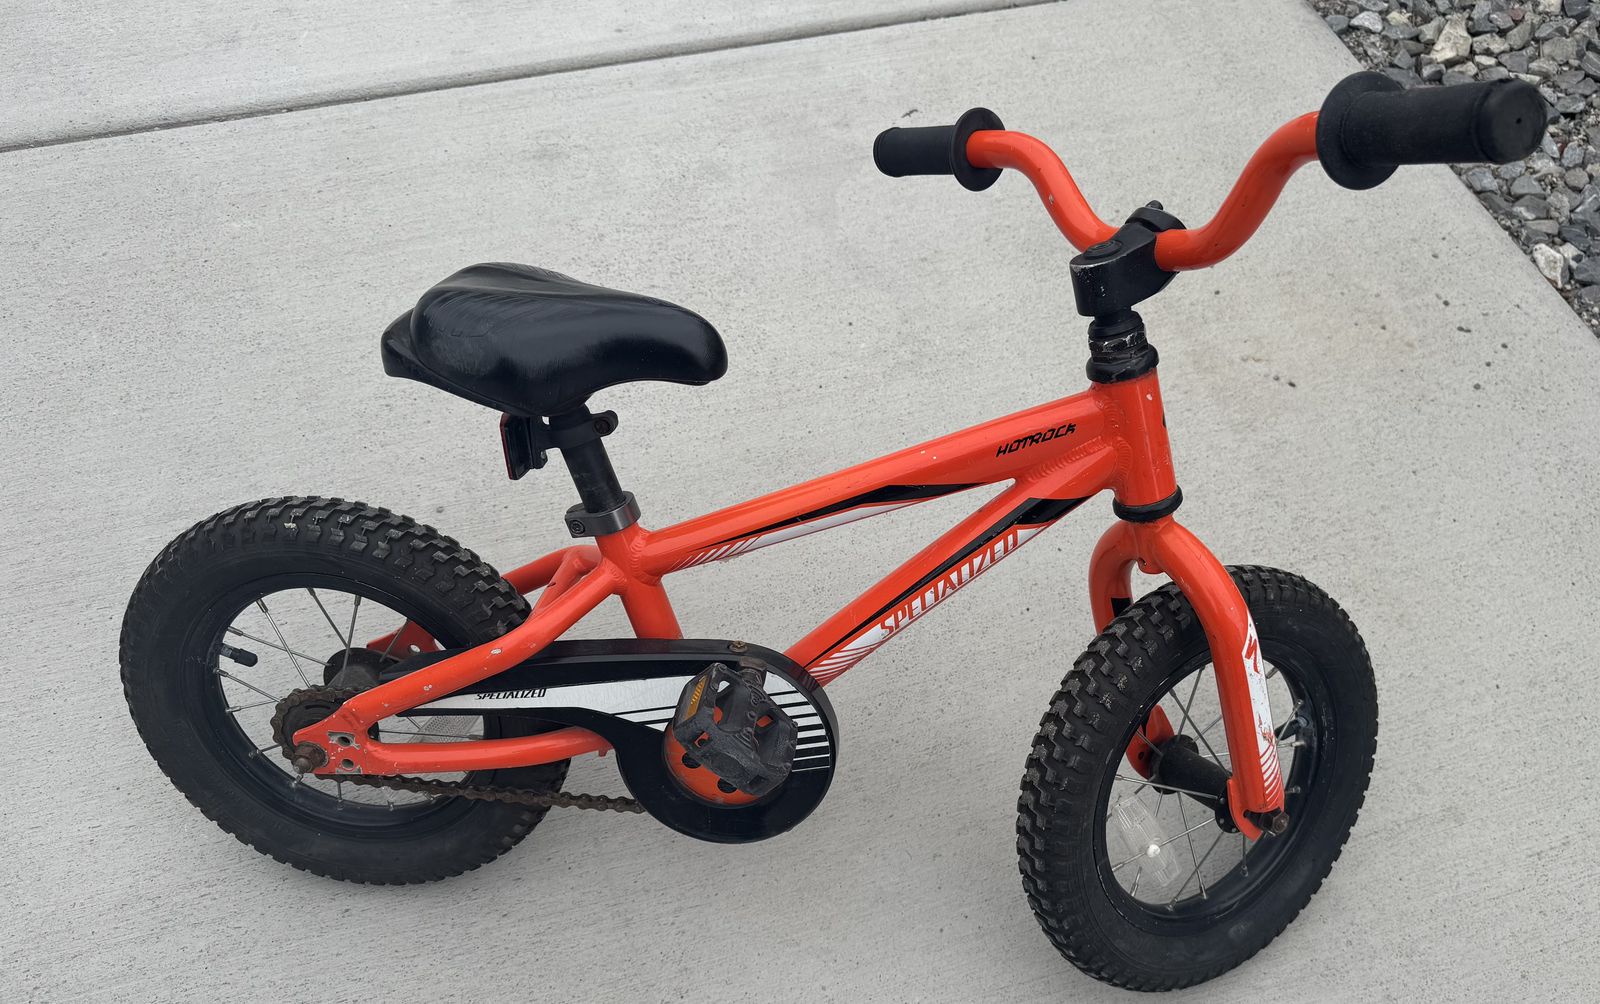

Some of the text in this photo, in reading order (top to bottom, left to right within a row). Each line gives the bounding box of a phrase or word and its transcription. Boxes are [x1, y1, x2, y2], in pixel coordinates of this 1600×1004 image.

[995, 423, 1077, 457] HOTROCK
[880, 529, 1019, 640] SPECIALIZED
[475, 687, 547, 700] SPECIALIZED
